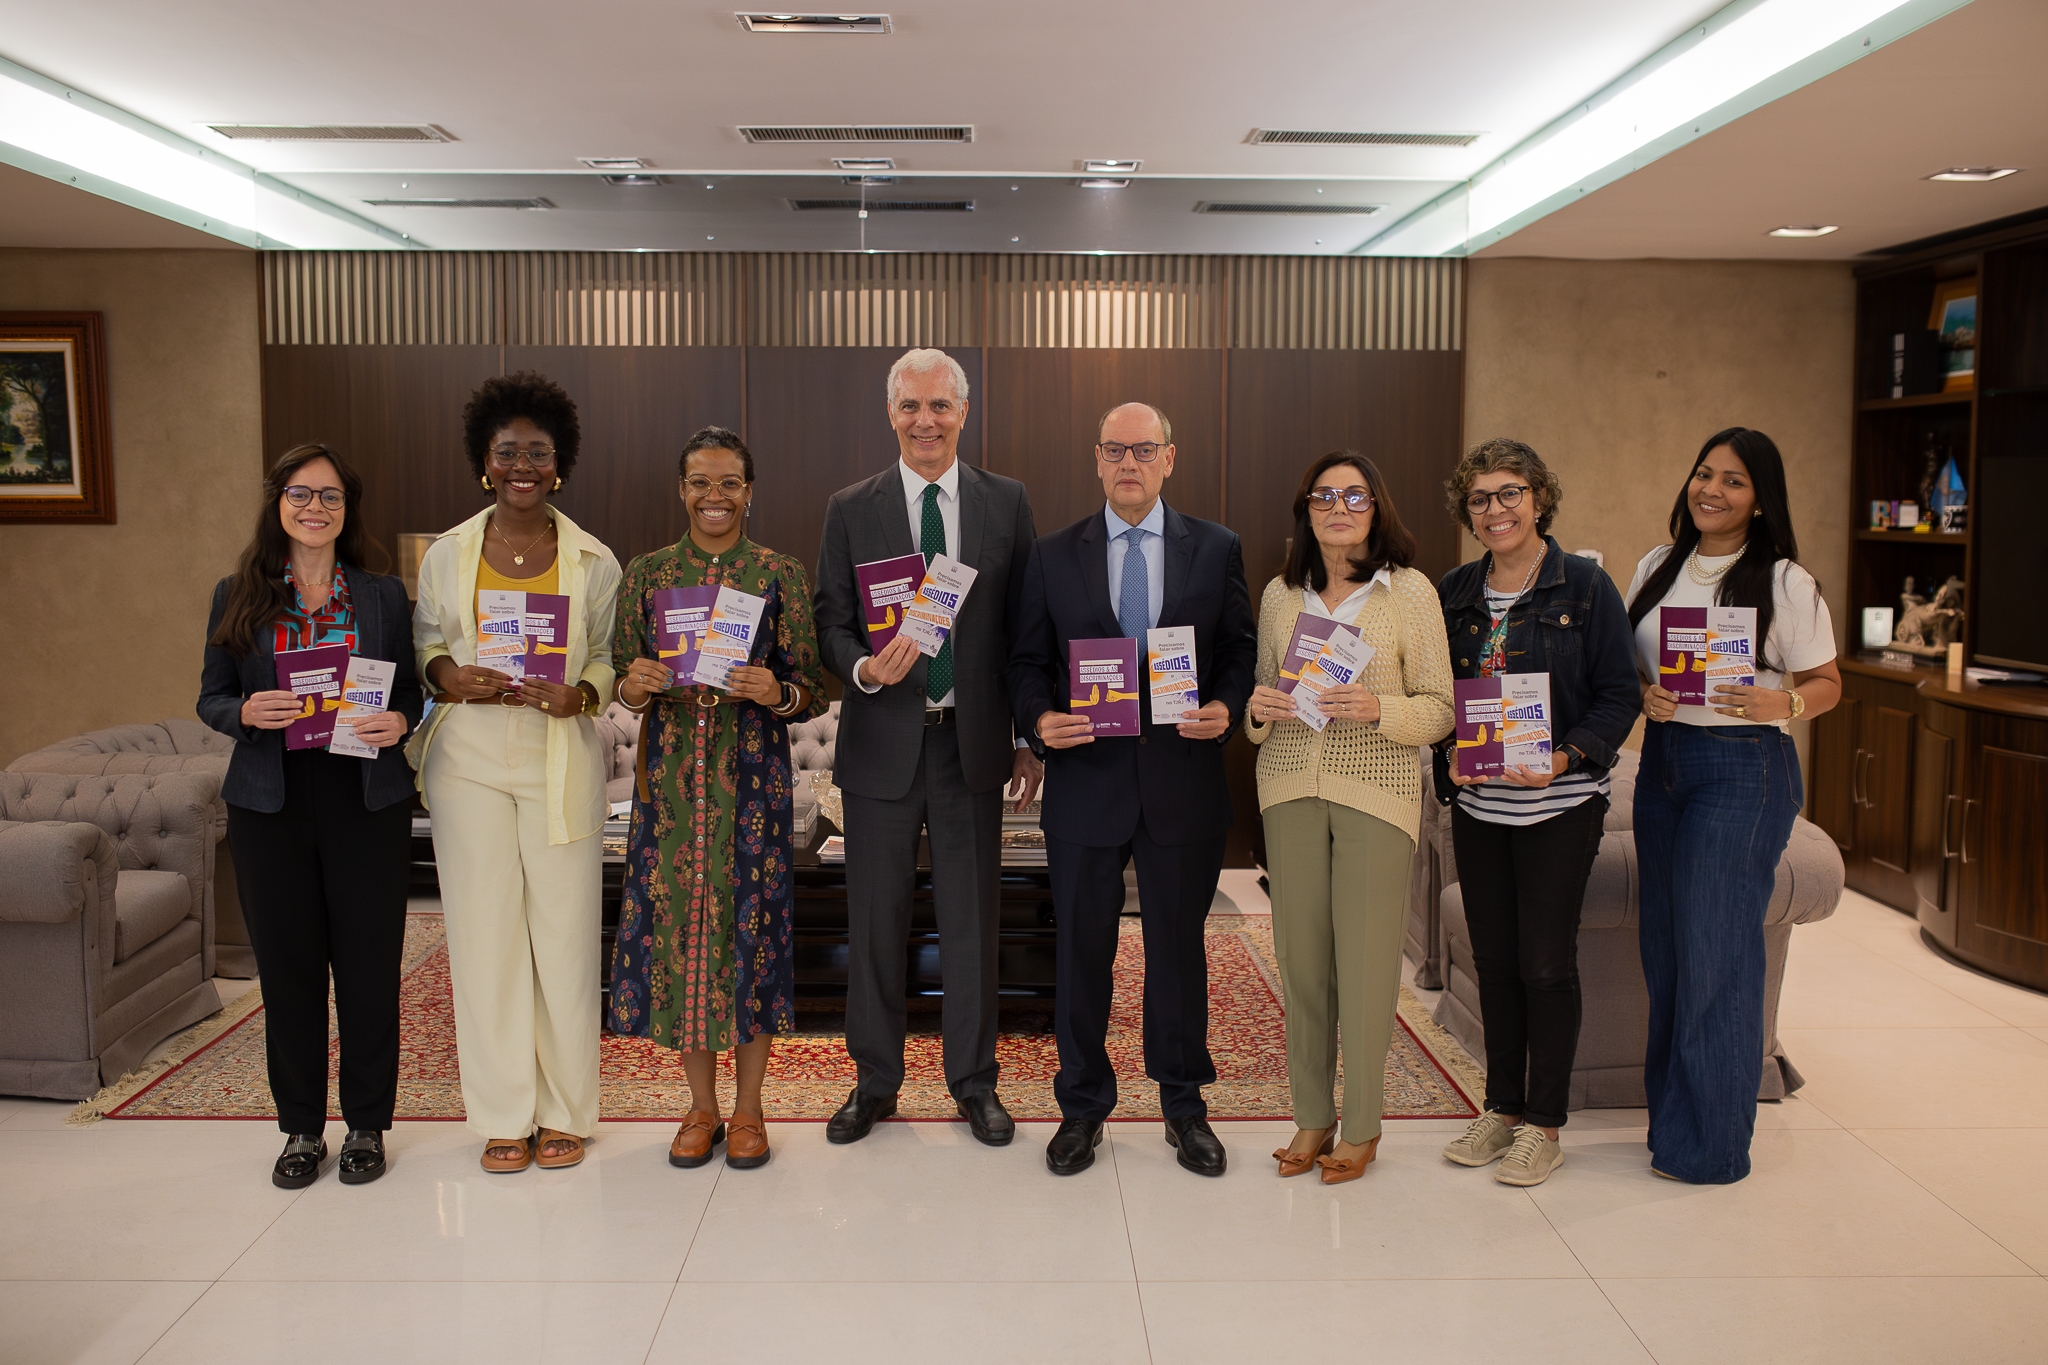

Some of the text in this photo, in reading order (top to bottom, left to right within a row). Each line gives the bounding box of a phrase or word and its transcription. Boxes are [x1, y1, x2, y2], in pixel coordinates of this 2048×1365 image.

[922, 586, 960, 610] ASSÉDIOS
[482, 619, 519, 634] ASSÉDIOS
[713, 620, 750, 640] ASSÉDIOS
[1711, 639, 1750, 654] ASSÉDIOS
[1154, 655, 1190, 671] ASSÉDIOS
[1318, 657, 1353, 684] ASSÉDIOS
[346, 690, 384, 706] ASSÉDIOS
[1507, 703, 1544, 719] ASSÉDIOS
